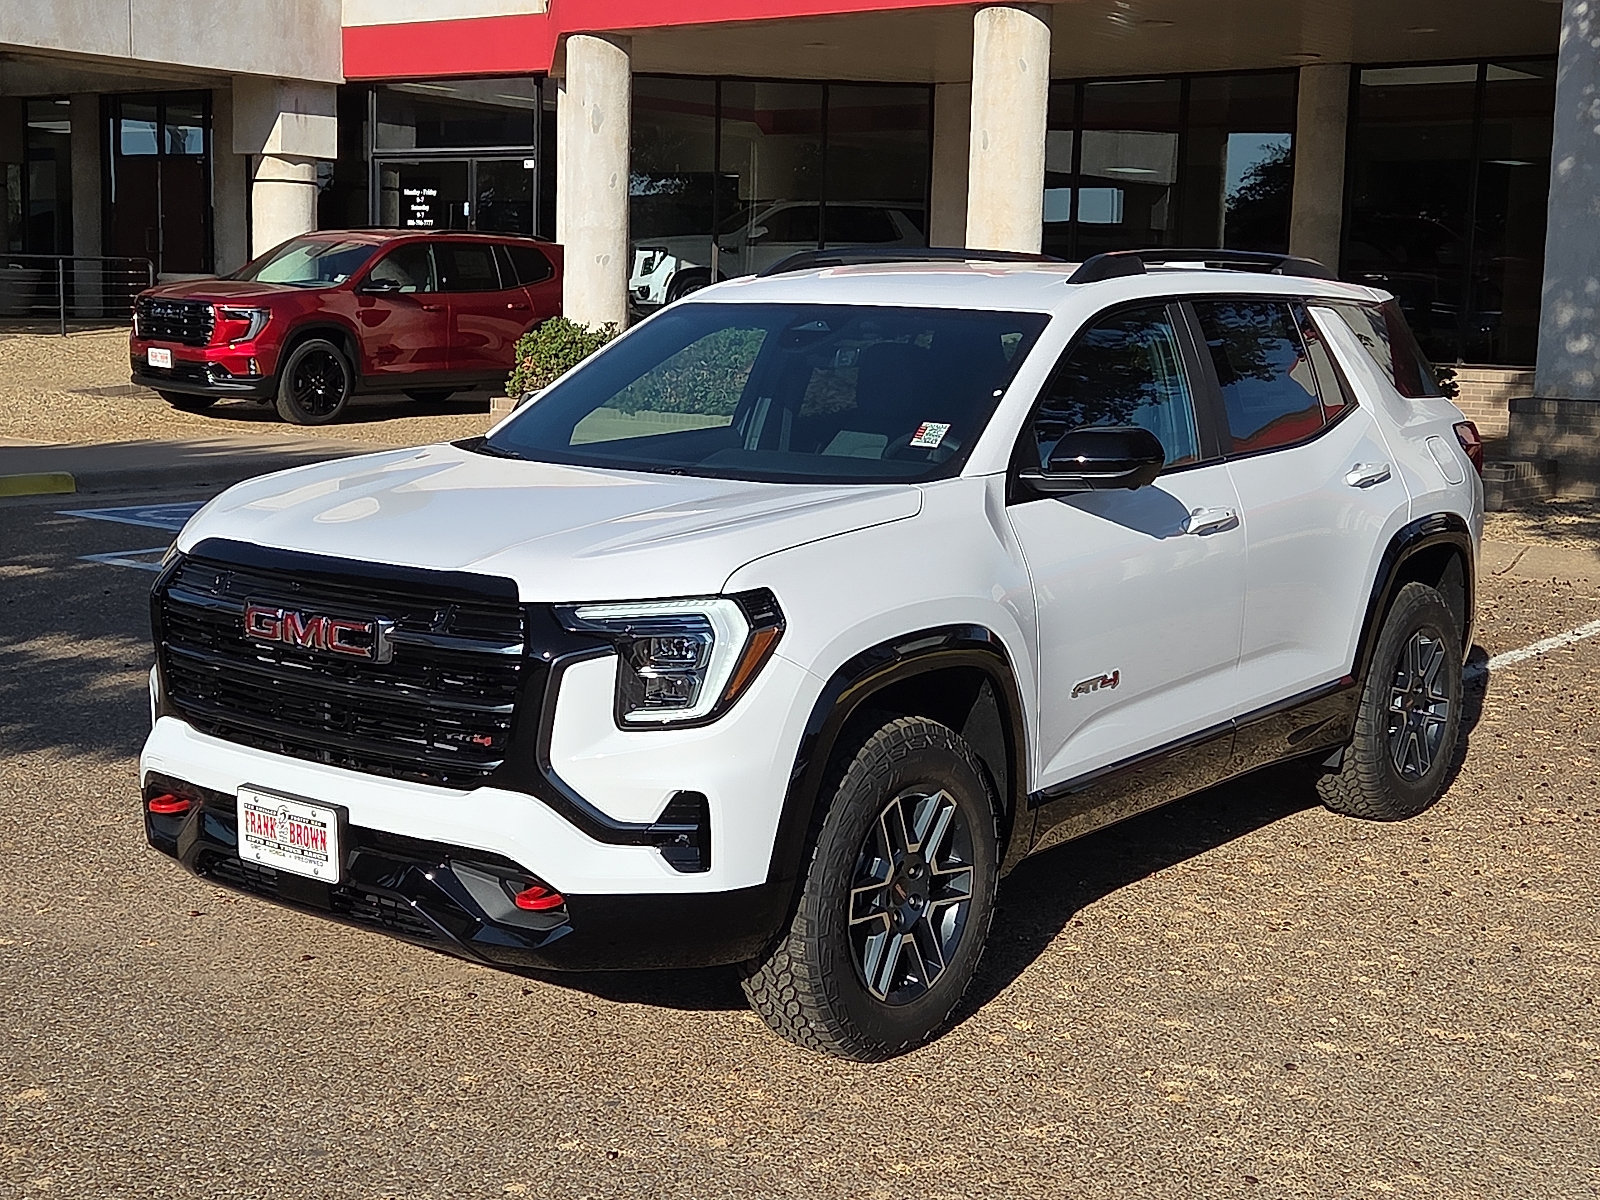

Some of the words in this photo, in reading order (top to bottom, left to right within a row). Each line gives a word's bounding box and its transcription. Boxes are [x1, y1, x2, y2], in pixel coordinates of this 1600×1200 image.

[411, 204, 429, 212] Saturday
[244, 605, 372, 658] GMC
[1071, 670, 1120, 698] AT4
[245, 810, 278, 841] FRANK
[288, 821, 328, 853] BROWN
